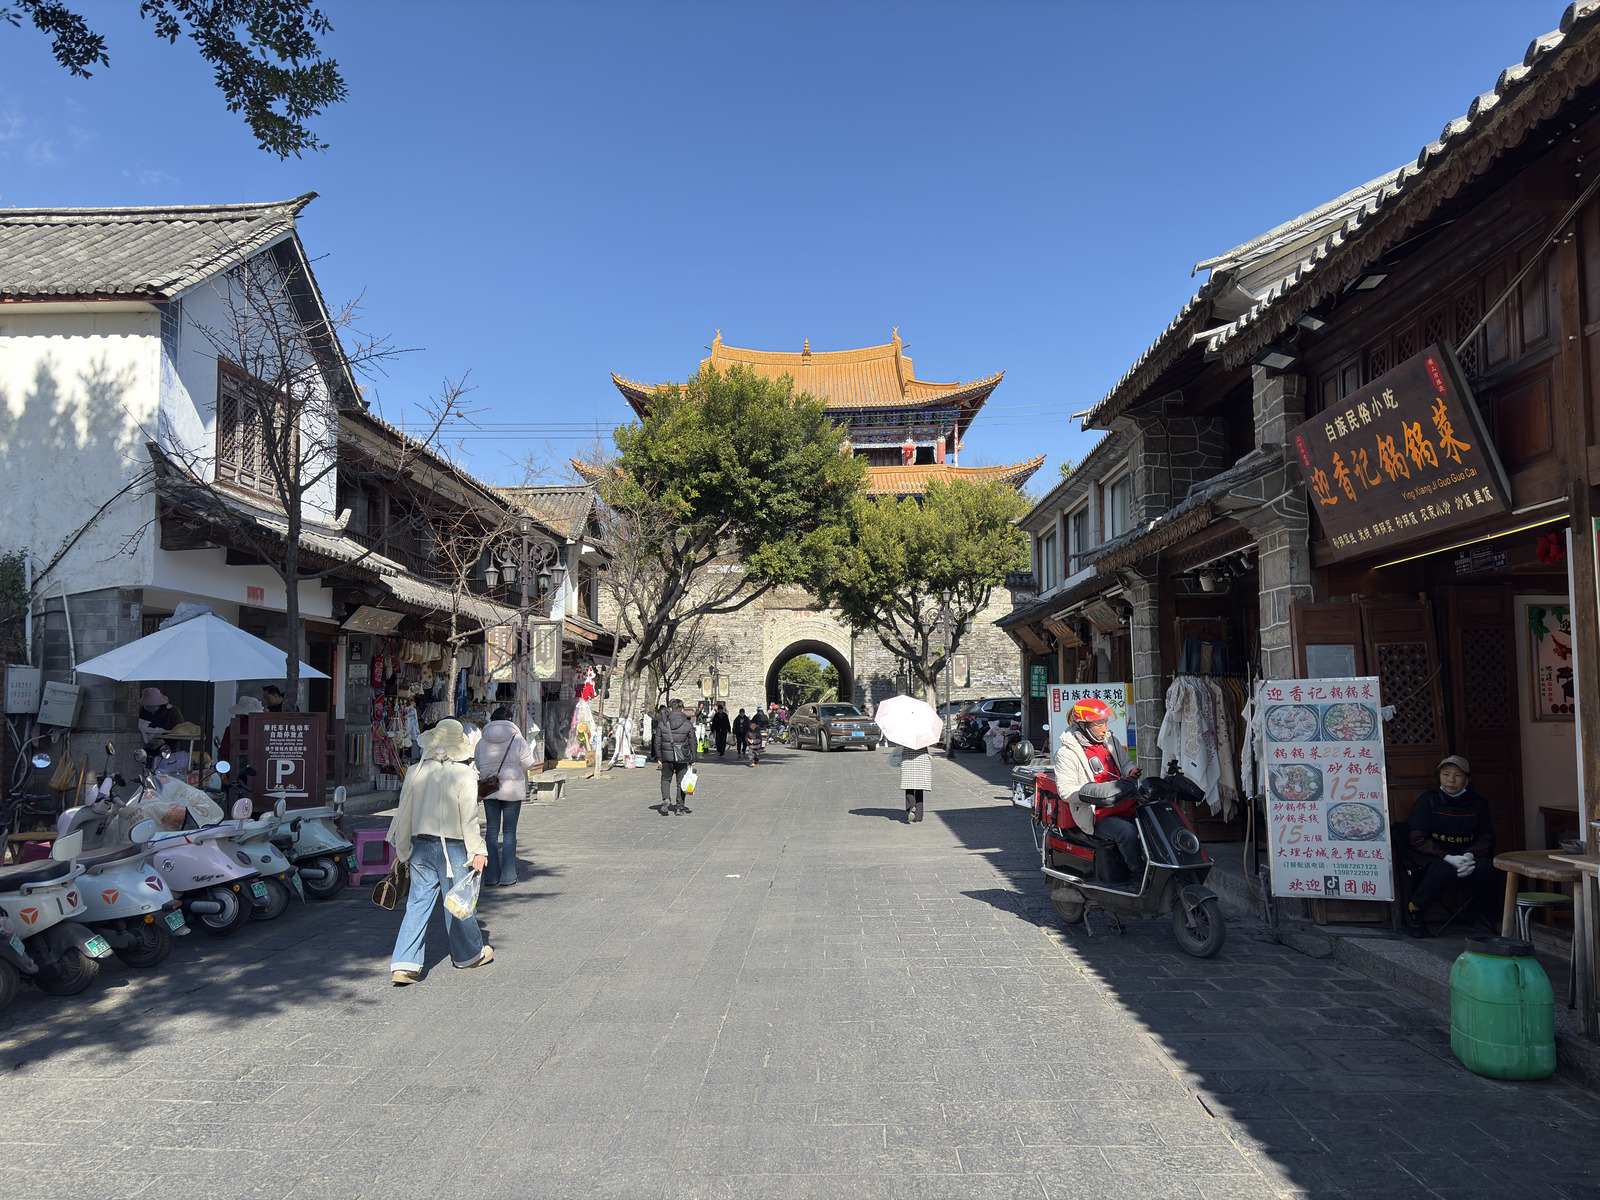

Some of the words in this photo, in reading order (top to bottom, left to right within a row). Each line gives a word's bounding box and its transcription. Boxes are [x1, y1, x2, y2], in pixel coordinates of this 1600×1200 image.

[1325, 387, 1399, 443] 白族民俗小吃
[1310, 397, 1471, 506] 迎香记锅锅菜
[1401, 491, 1416, 501] Ying
[1414, 484, 1433, 495] Xiang
[1432, 480, 1438, 491] Ji
[1437, 478, 1452, 488] Guo
[1450, 472, 1466, 483] Guo
[1464, 466, 1478, 478] Cai
[1419, 499, 1452, 522] 农家小炒
[1454, 492, 1474, 511] 炒饭
[1473, 485, 1494, 504] 盖饭
[1033, 665, 1045, 675] 药
[1061, 688, 1123, 701] 白族农家菜馆
[1266, 684, 1375, 702] 迎香记锅锅菜
[270, 731, 304, 739] 自助停放点
[1272, 746, 1374, 760] 锅锅菜22元起
[276, 760, 295, 784] P
[1326, 762, 1382, 775] 砂锅饭
[1272, 802, 1319, 812] 砂锅饵丝
[1272, 813, 1320, 824] 砂锅米线
[1277, 847, 1385, 861] 大理古城免费配送
[1332, 862, 1378, 870] 13987267123
[1333, 869, 1379, 877] 13987229278
[1289, 878, 1323, 892] 欢迎
[1344, 880, 1377, 896] 团购
